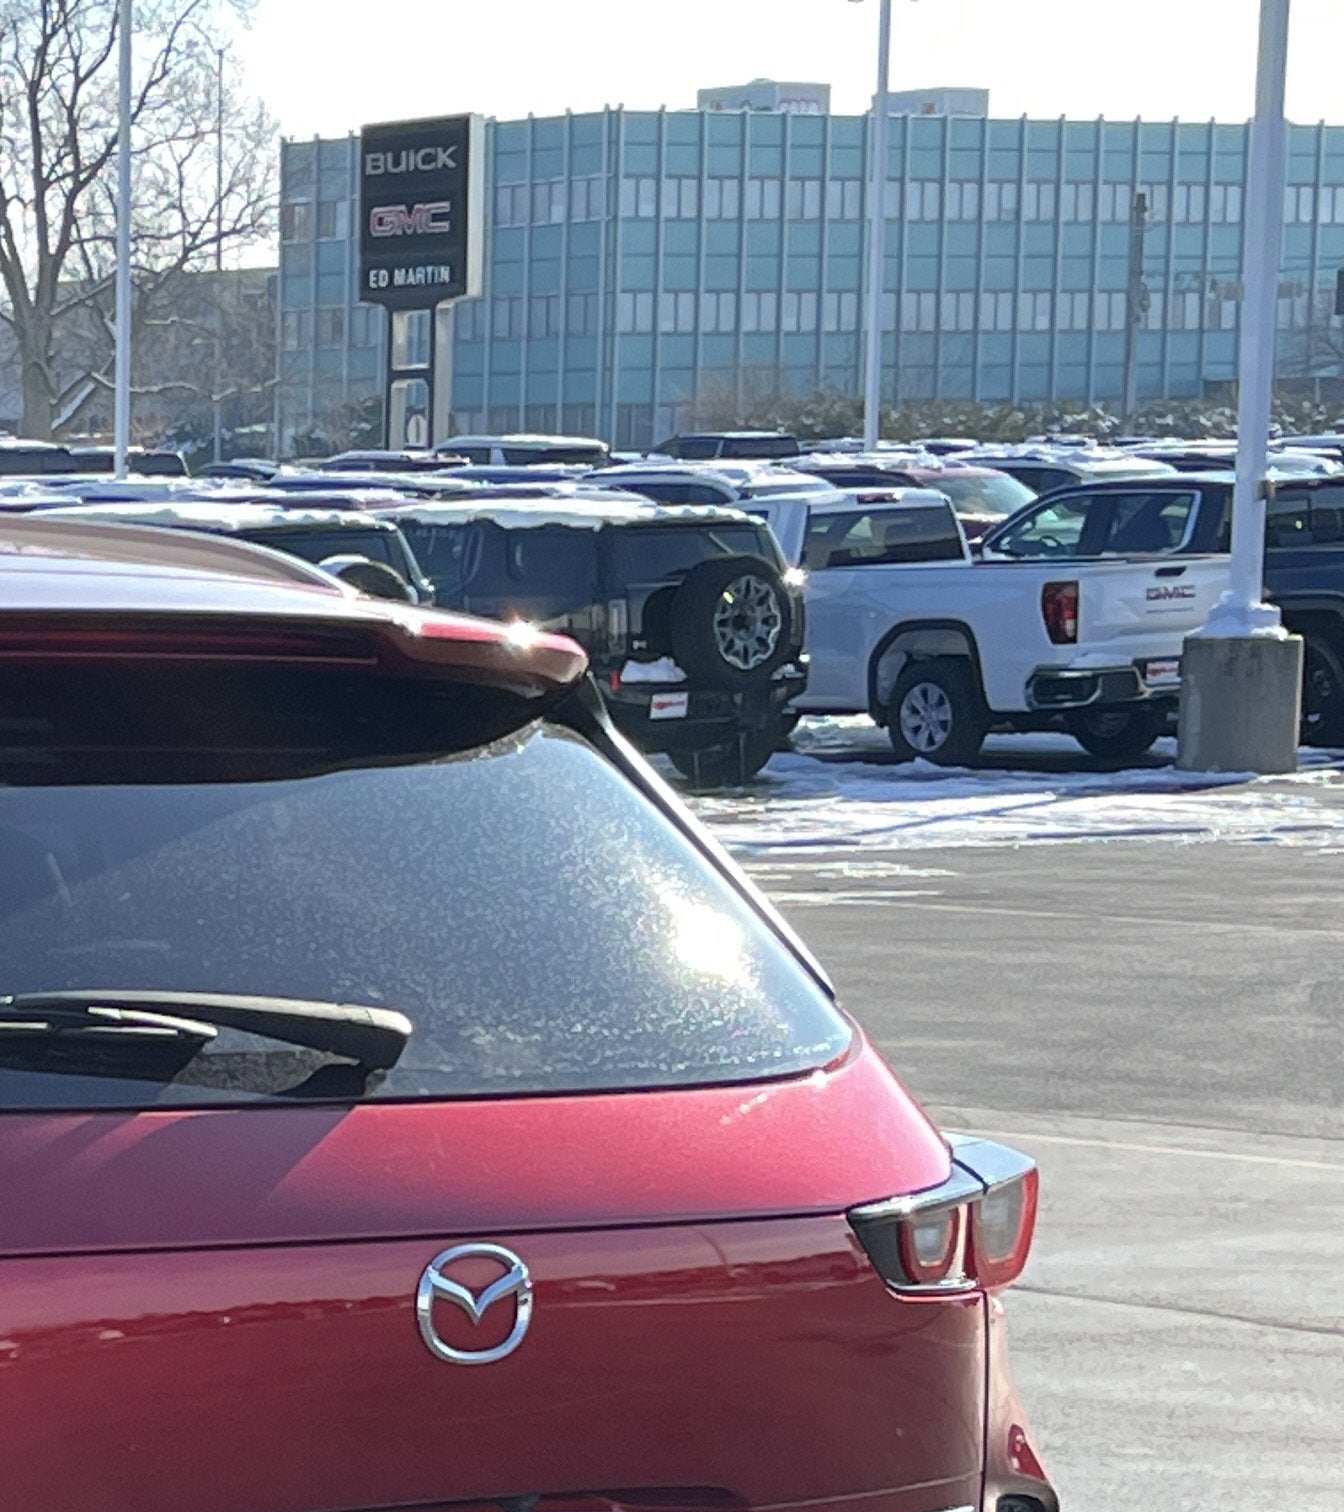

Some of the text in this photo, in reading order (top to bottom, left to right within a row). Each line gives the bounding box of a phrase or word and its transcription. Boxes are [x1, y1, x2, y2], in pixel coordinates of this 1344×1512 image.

[365, 145, 458, 175] BUICK
[370, 201, 450, 237] GMC
[369, 265, 450, 288] ED MARTIN
[1146, 585, 1196, 601] GMC
